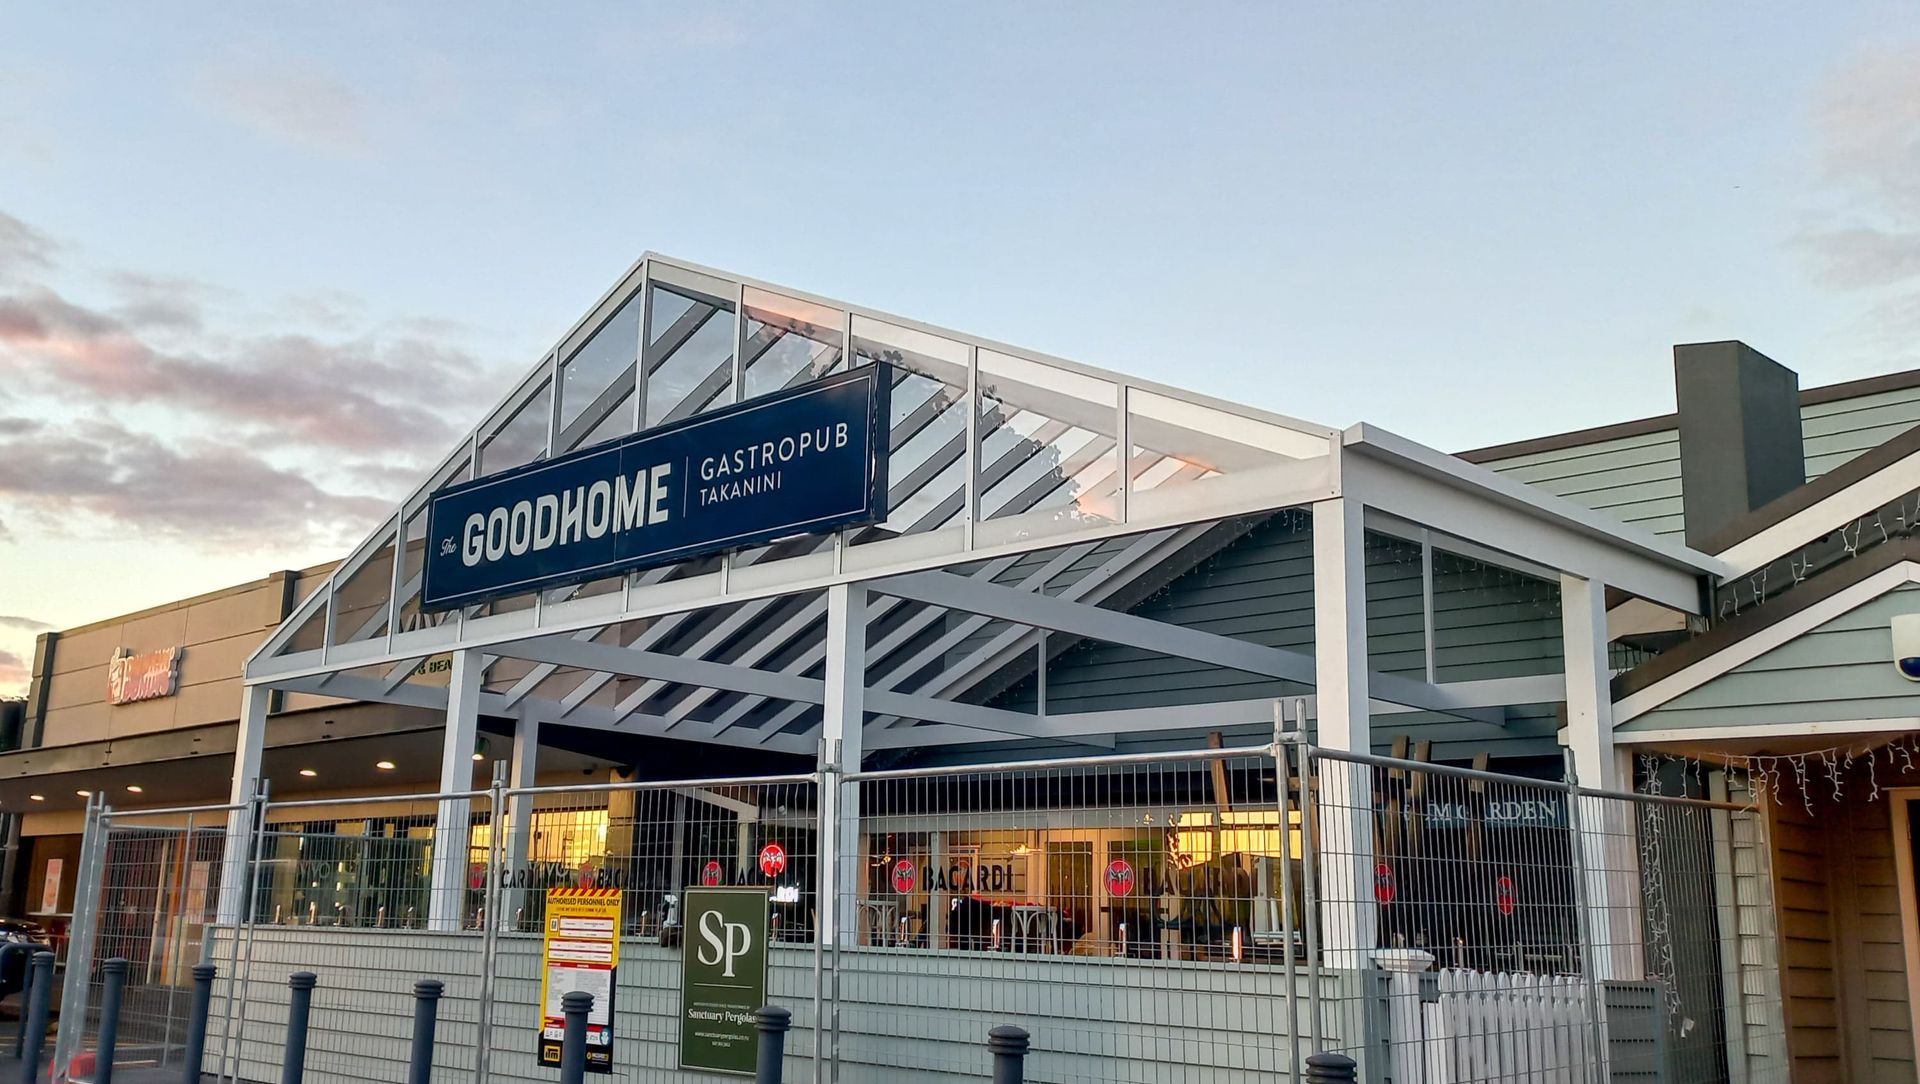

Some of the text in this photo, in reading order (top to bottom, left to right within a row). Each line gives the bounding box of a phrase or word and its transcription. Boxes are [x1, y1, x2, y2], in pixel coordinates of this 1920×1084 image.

[700, 422, 848, 481] GASTROPUB
[700, 470, 781, 507] TAKANINI
[440, 462, 672, 567] The GOODHOME
[922, 864, 1013, 891] BACARDI
[548, 897, 620, 907] AUTHORISED PERSONNEL ONLY
[697, 910, 751, 977] SP
[688, 1008, 757, 1026] Sanctuary Pergolas
